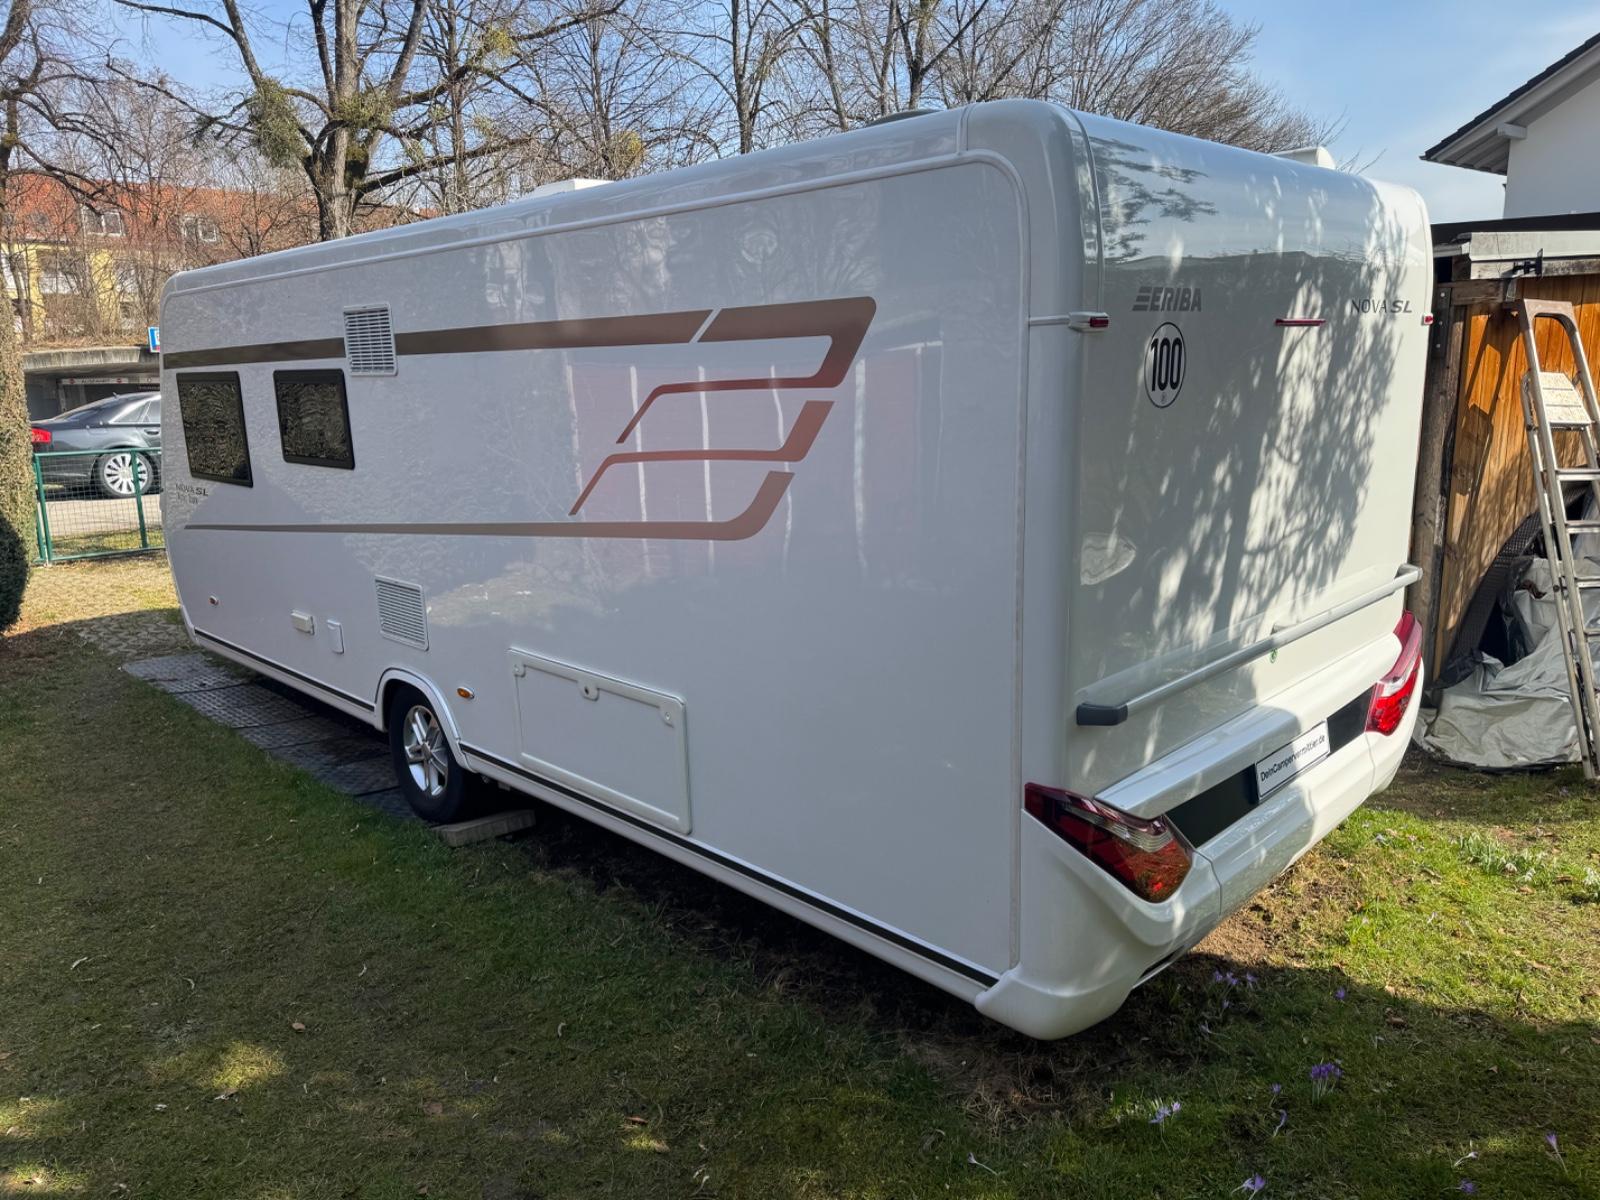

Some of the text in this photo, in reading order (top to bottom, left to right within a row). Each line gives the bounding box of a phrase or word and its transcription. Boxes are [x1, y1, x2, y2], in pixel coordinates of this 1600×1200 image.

[1149, 287, 1201, 312] ERIBA
[1351, 299, 1412, 314] NOVA SL
[1151, 337, 1182, 392] 100
